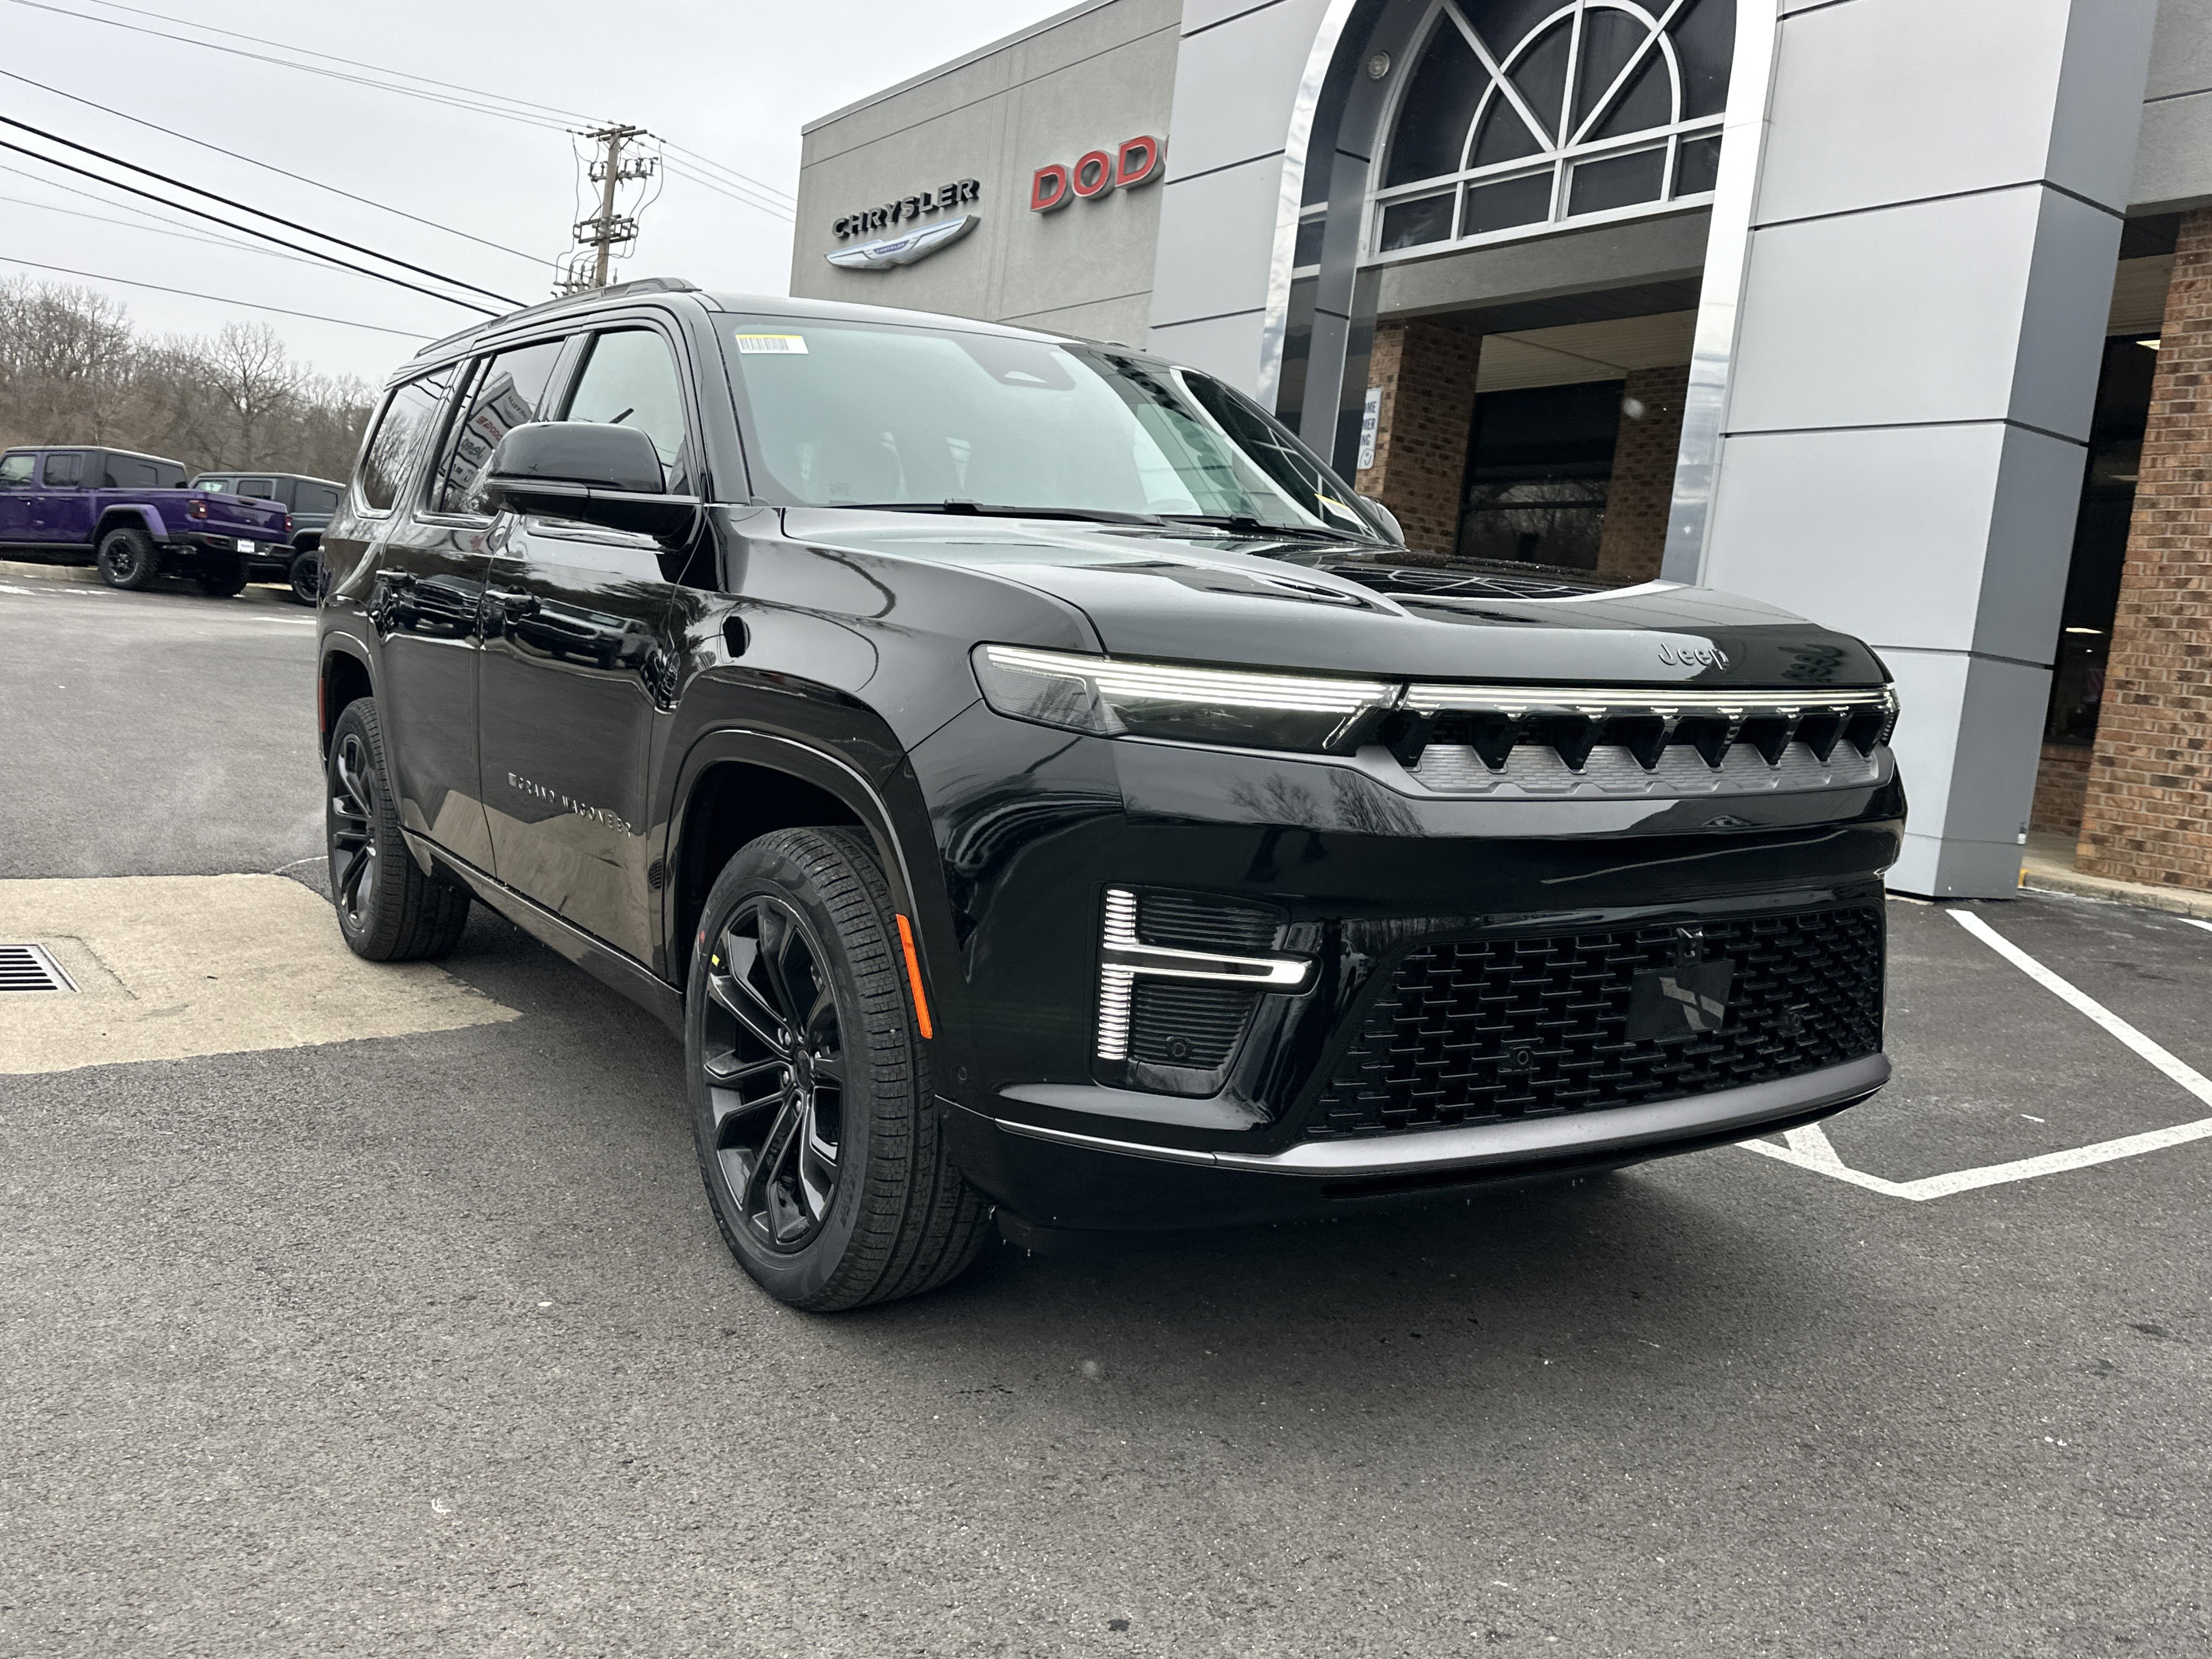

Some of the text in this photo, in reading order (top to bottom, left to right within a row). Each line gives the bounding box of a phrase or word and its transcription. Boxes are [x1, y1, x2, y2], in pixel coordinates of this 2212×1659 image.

[1031, 135, 1169, 213] DOD
[832, 177, 979, 238] CHRYSLER
[1658, 642, 1729, 671] Jeep
[518, 777, 631, 837] GRAND WAGONEER
